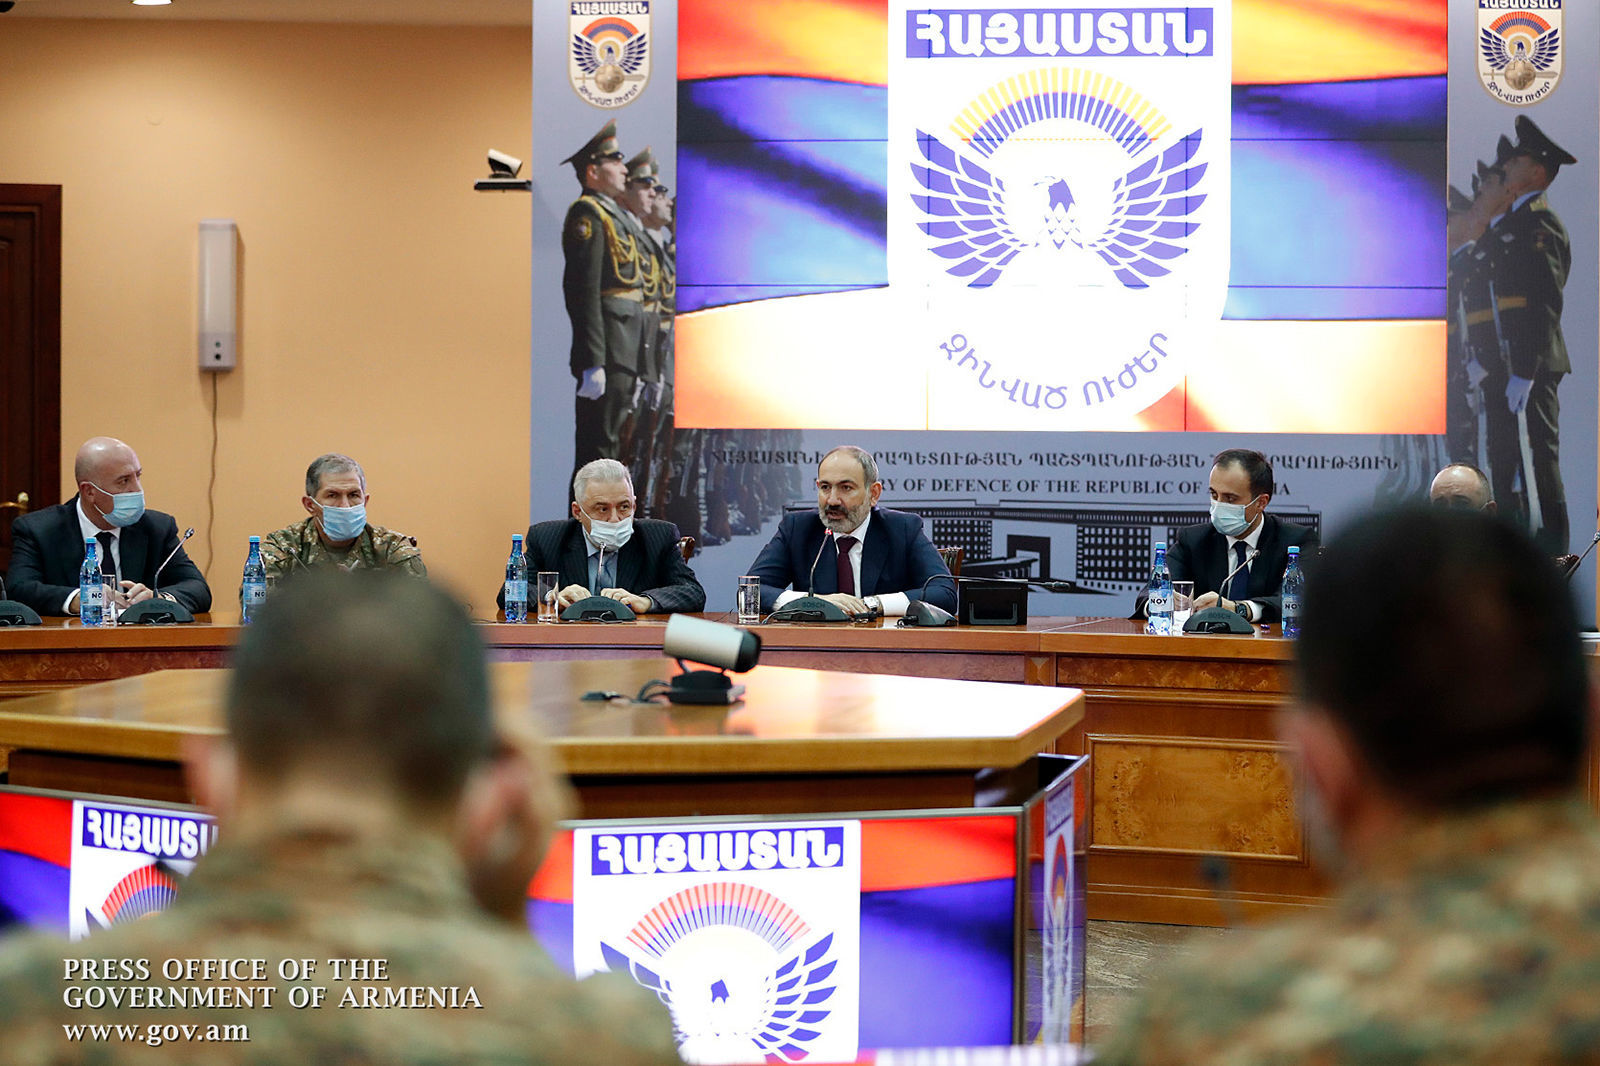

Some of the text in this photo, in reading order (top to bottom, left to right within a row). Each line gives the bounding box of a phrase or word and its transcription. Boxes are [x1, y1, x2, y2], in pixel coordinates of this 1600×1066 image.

[573, 2, 647, 14] ՀԱՅԱՍՏԱՆ
[916, 12, 1207, 56] ՀԱՅԱՍՏԱՆ
[939, 333, 1067, 409] ԶԻՆՎԱԾ
[873, 451, 1022, 466] ՐԱՊԵՏՈՒԹՅԱՆ
[1029, 452, 1206, 468] ՊԱՇՏՊԱՆՈՒԹՅԱՆ
[903, 478, 927, 492] OF
[932, 478, 1012, 492] DEFENCE
[1016, 479, 1040, 493] OF
[1044, 479, 1081, 493] THE
[1086, 480, 1174, 494] REPUBLIC
[1178, 481, 1203, 494] OF
[598, 829, 841, 874] ՀԱՅԱՍՏԱՆ
